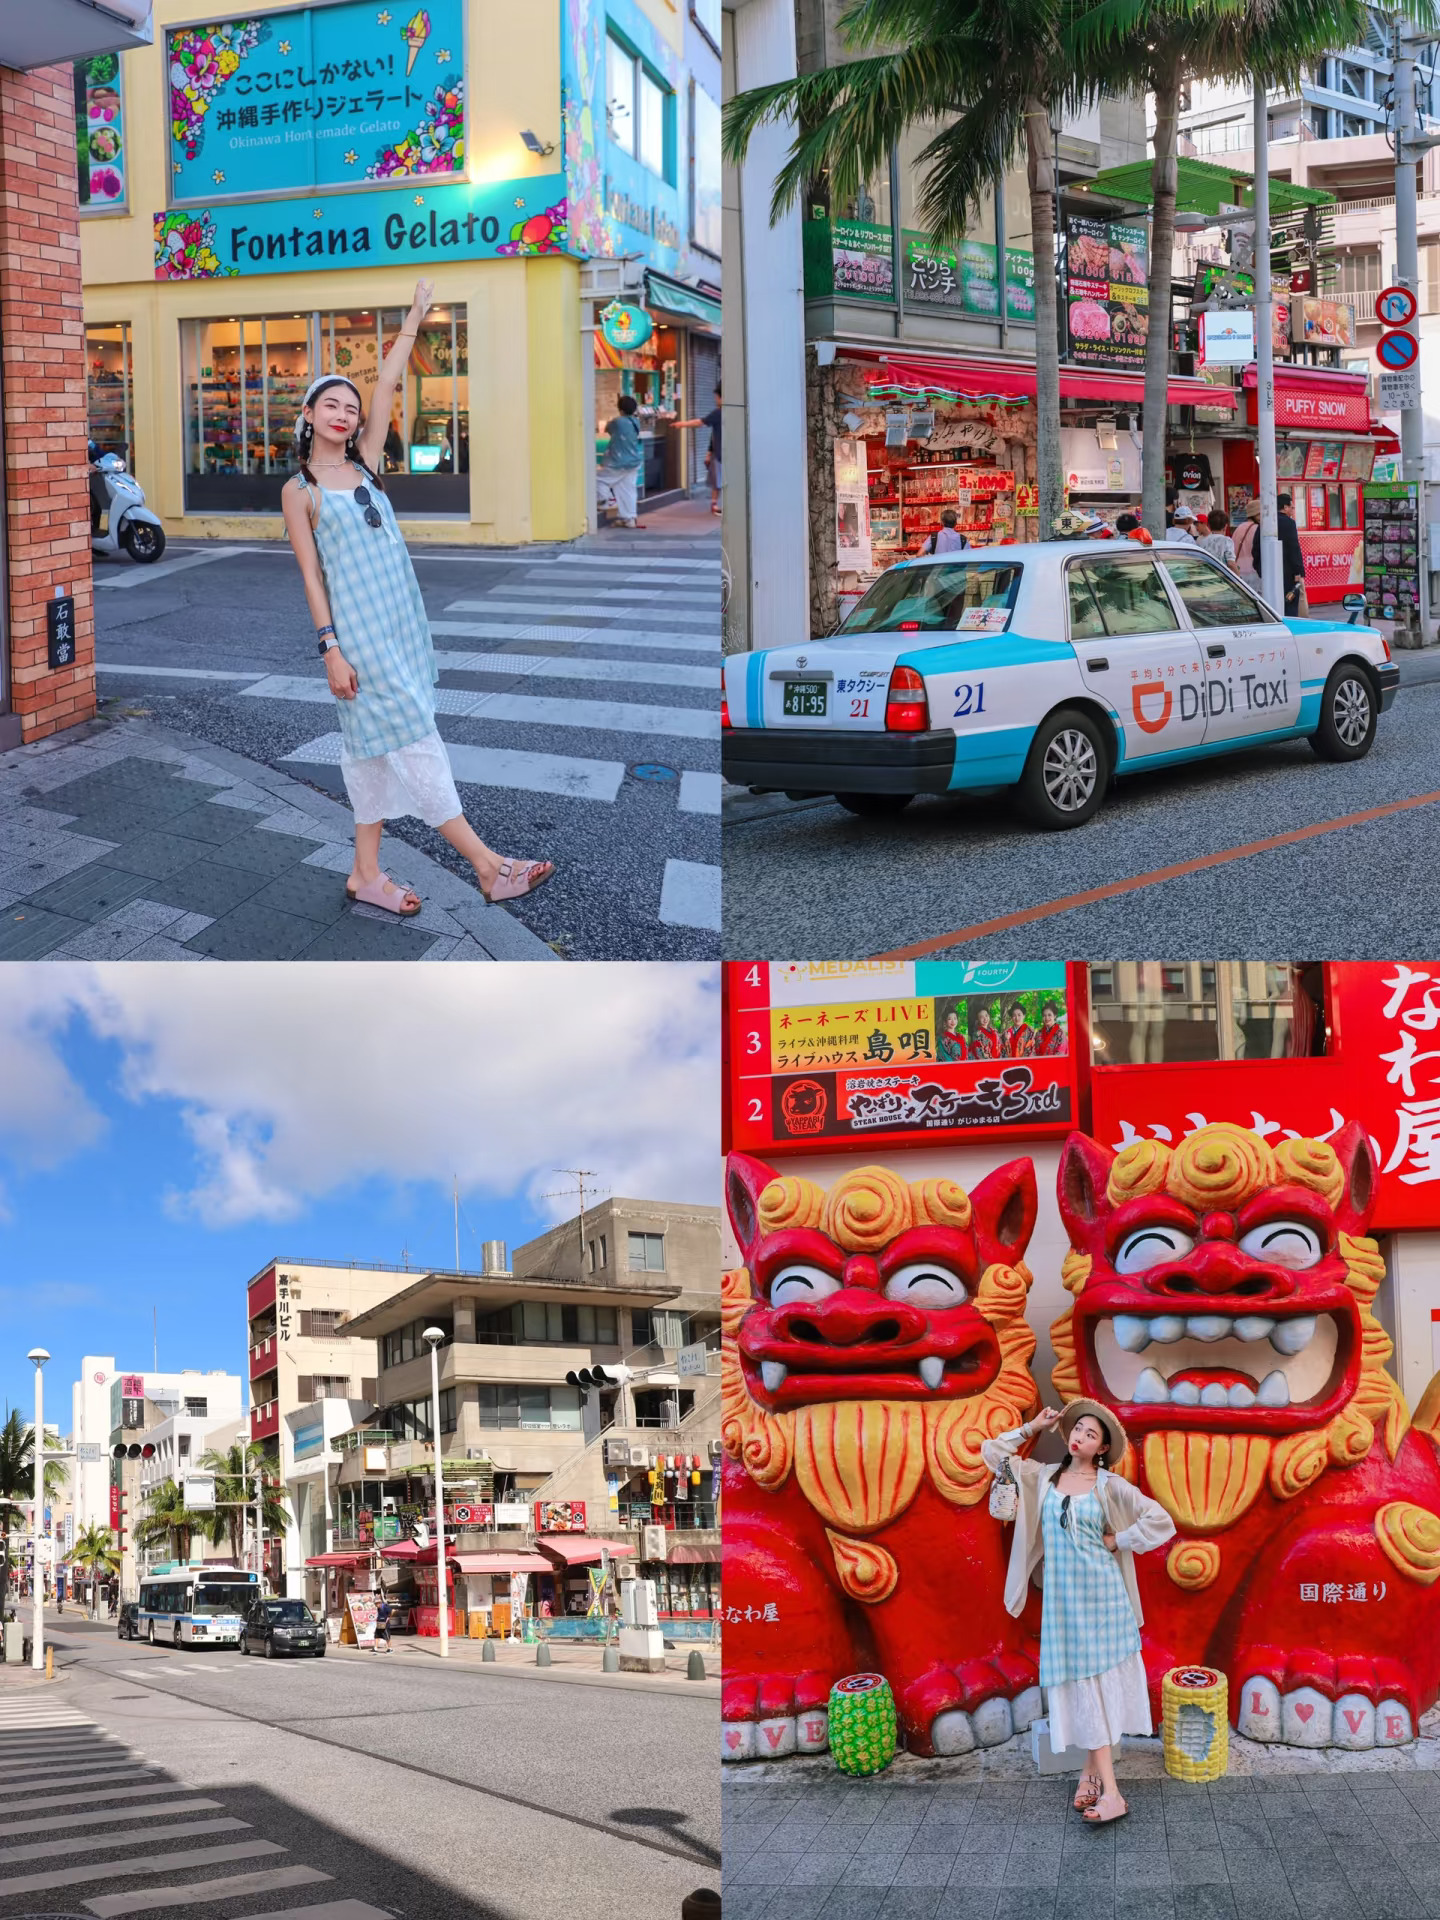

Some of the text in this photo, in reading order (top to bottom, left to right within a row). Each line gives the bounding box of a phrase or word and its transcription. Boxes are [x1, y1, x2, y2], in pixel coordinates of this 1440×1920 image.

[235, 54, 394, 95] ここにしかない!
[216, 85, 423, 130] 沖縄手作りジェラート
[229, 134, 281, 149] Okinawa
[359, 120, 401, 134] Gelato
[231, 209, 500, 262] Fontana Gelato
[907, 253, 952, 275] ごりら
[1012, 264, 1035, 277] 100g
[906, 272, 957, 294] パンチ
[1286, 398, 1347, 416] PUFFY SNOW
[1383, 399, 1414, 408] ここまで
[1061, 518, 1072, 529] 東
[1306, 555, 1331, 567] PUFFY
[55, 602, 71, 663] 石敢當
[1130, 648, 1287, 680] 平均5分で来るタクシーアプリ
[837, 678, 886, 693] 東タクシー
[1180, 669, 1288, 721] DiDi Taxi
[792, 696, 824, 713] 81-95
[849, 698, 870, 717] 21
[954, 683, 986, 717] 21
[744, 964, 761, 987] 4
[978, 968, 1009, 976] FOURTH
[778, 1004, 929, 1030] ネーネーズ LIVE
[746, 1031, 762, 1055] 3
[778, 1034, 859, 1049] ライブ&沖縄料理
[862, 1028, 932, 1063] 島唄
[778, 1051, 858, 1068] ライブハウス
[846, 1075, 920, 1090] 溶岩焼きステーキ
[910, 1067, 1058, 1119] ステーキ 3rd
[747, 1099, 763, 1122] 2
[853, 1114, 903, 1127] STEAK HOUSE
[926, 1116, 1000, 1127] 国際通り がじゅまる店
[793, 1121, 817, 1130] STEAK
[1299, 1581, 1387, 1603] 国際通り
[720, 1602, 780, 1624] なわ屋
